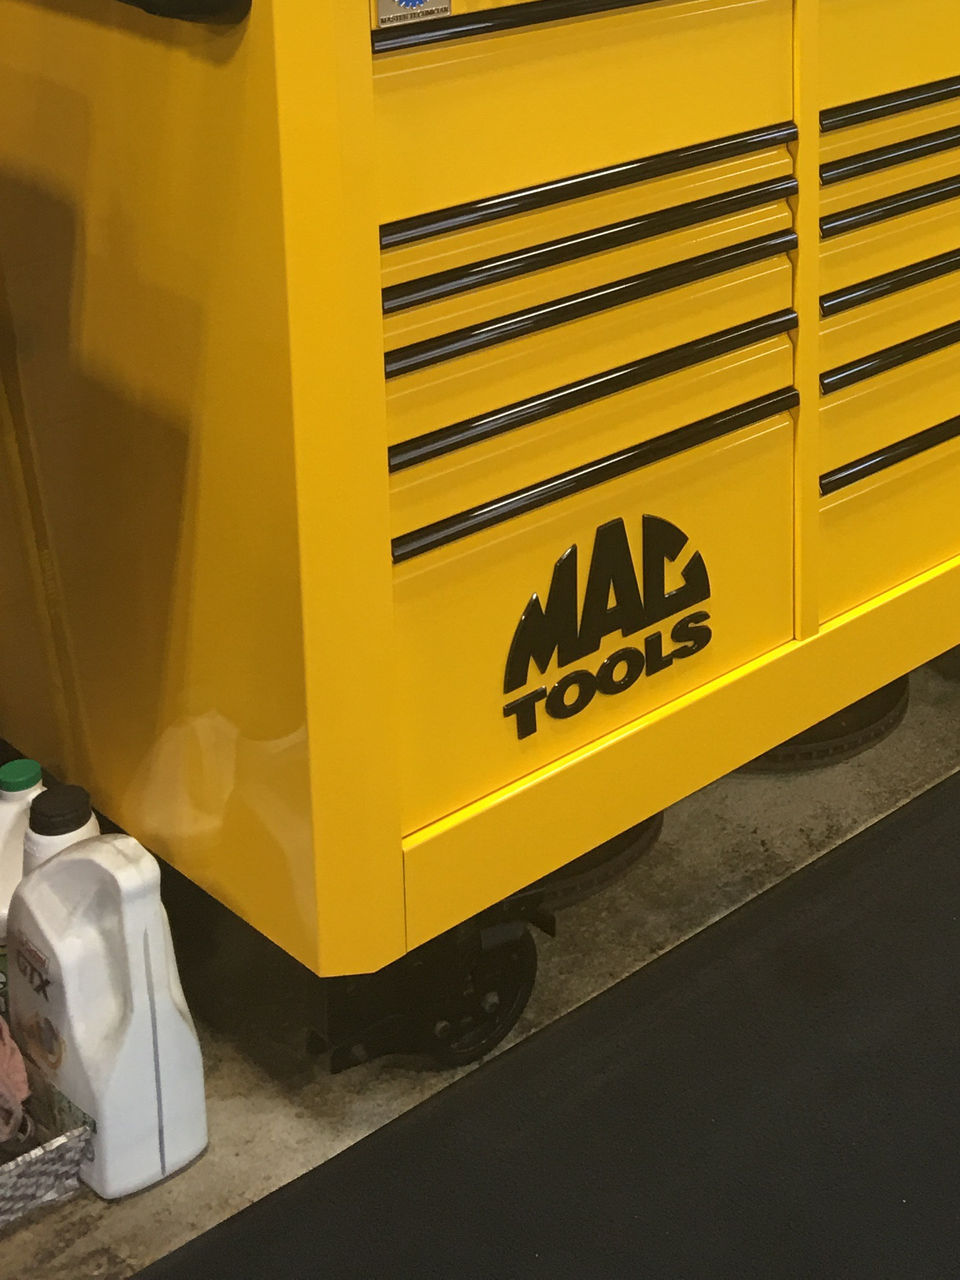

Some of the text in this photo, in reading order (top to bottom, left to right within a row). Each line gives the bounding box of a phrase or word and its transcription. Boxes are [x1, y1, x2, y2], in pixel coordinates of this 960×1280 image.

[380, 14, 409, 24] MASTER
[503, 513, 711, 695] MAC
[502, 610, 712, 740] TOOLS
[16, 948, 51, 1002] GTX
